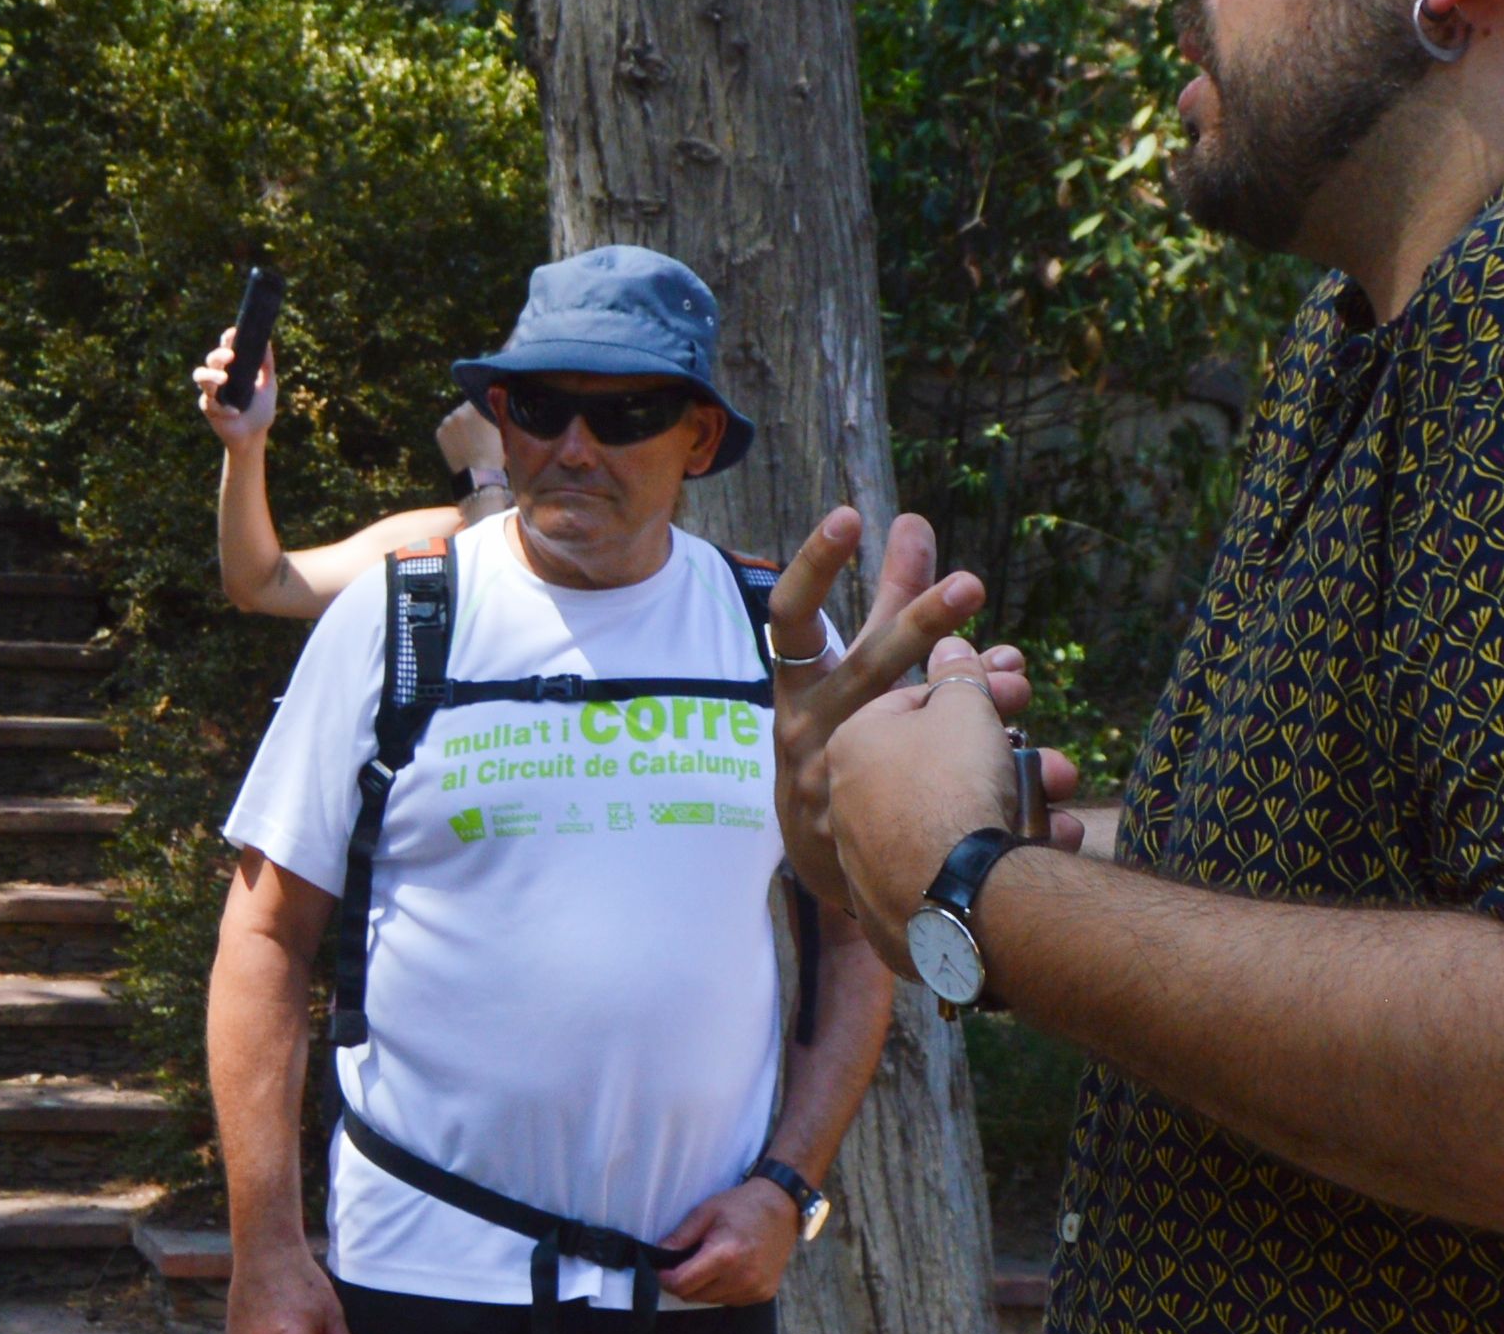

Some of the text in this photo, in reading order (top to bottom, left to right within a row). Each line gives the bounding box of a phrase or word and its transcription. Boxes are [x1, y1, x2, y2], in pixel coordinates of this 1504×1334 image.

[444, 696, 760, 758] mulla't i corre
[441, 750, 761, 791] al Circuit de Catalunya
